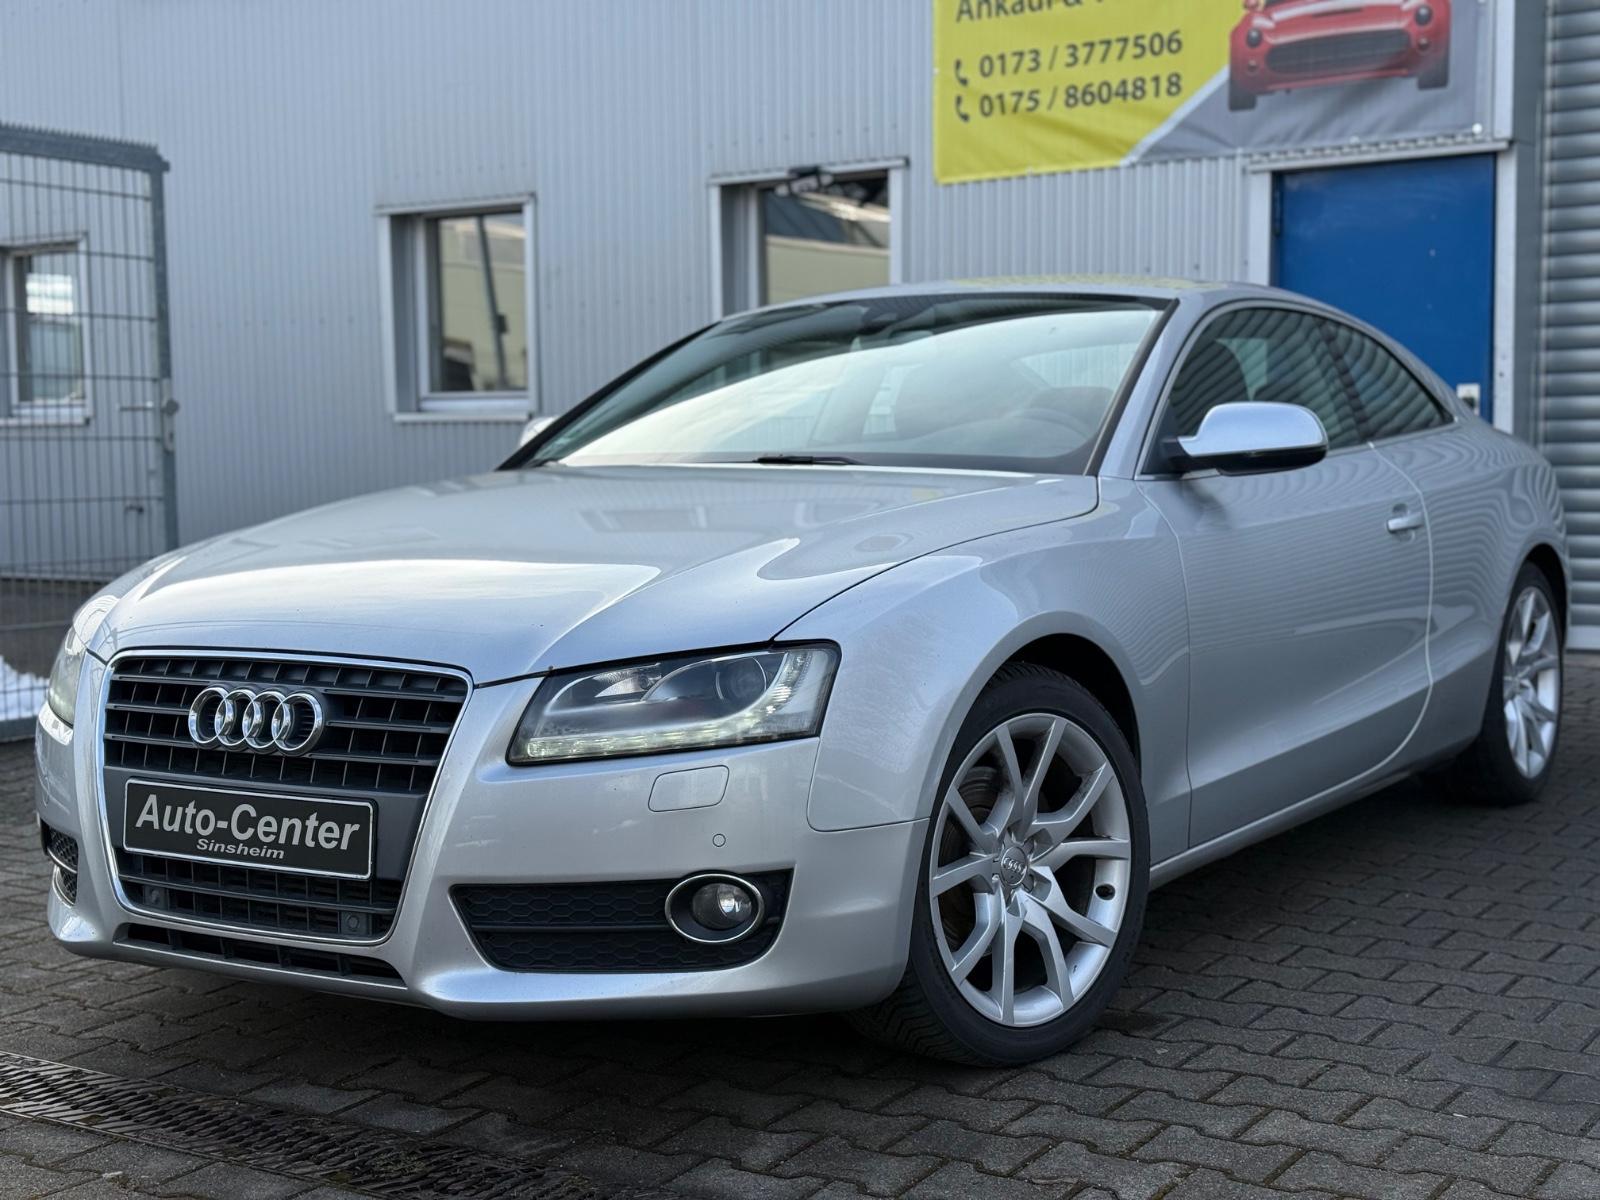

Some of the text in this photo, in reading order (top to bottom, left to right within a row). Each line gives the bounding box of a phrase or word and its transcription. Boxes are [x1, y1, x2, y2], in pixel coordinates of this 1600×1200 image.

[979, 49, 1041, 78] 0173
[1064, 30, 1183, 68] 3777506
[979, 89, 1041, 117] 0175
[1064, 72, 1182, 108] 8604818
[135, 793, 360, 850] Auto-Center
[196, 838, 285, 859] Sinsheim
